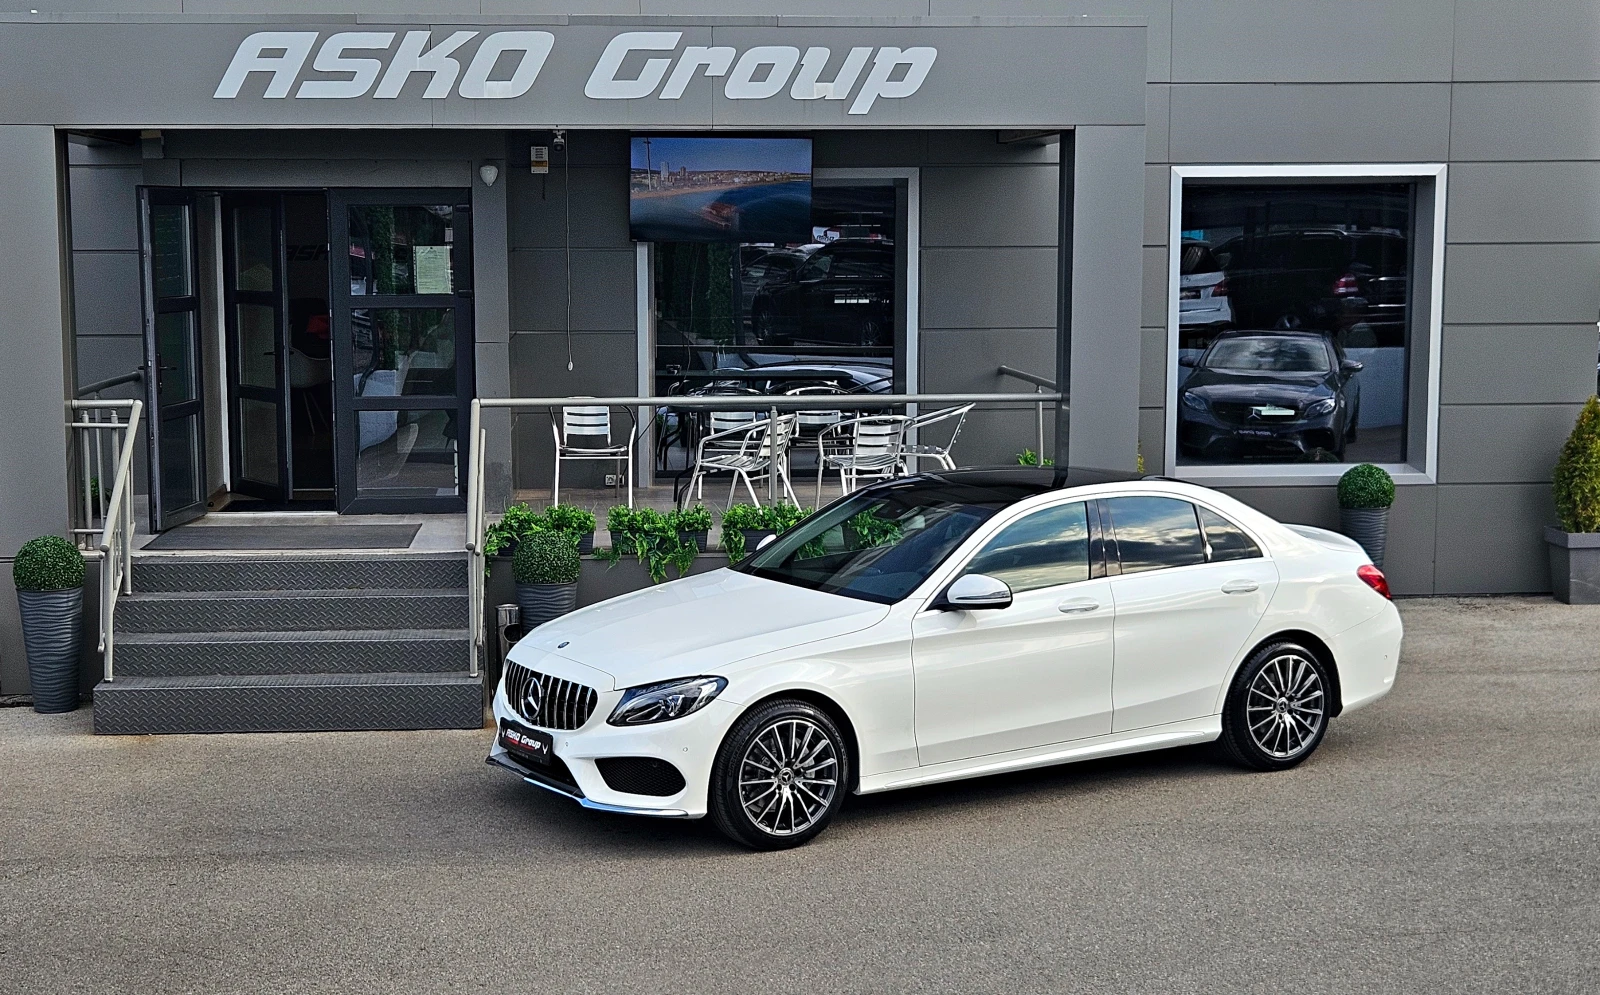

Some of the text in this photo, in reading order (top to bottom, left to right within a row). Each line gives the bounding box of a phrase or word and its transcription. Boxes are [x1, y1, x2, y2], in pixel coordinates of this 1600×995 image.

[213, 30, 938, 116] ASKO Group
[521, 735, 541, 750] Group
